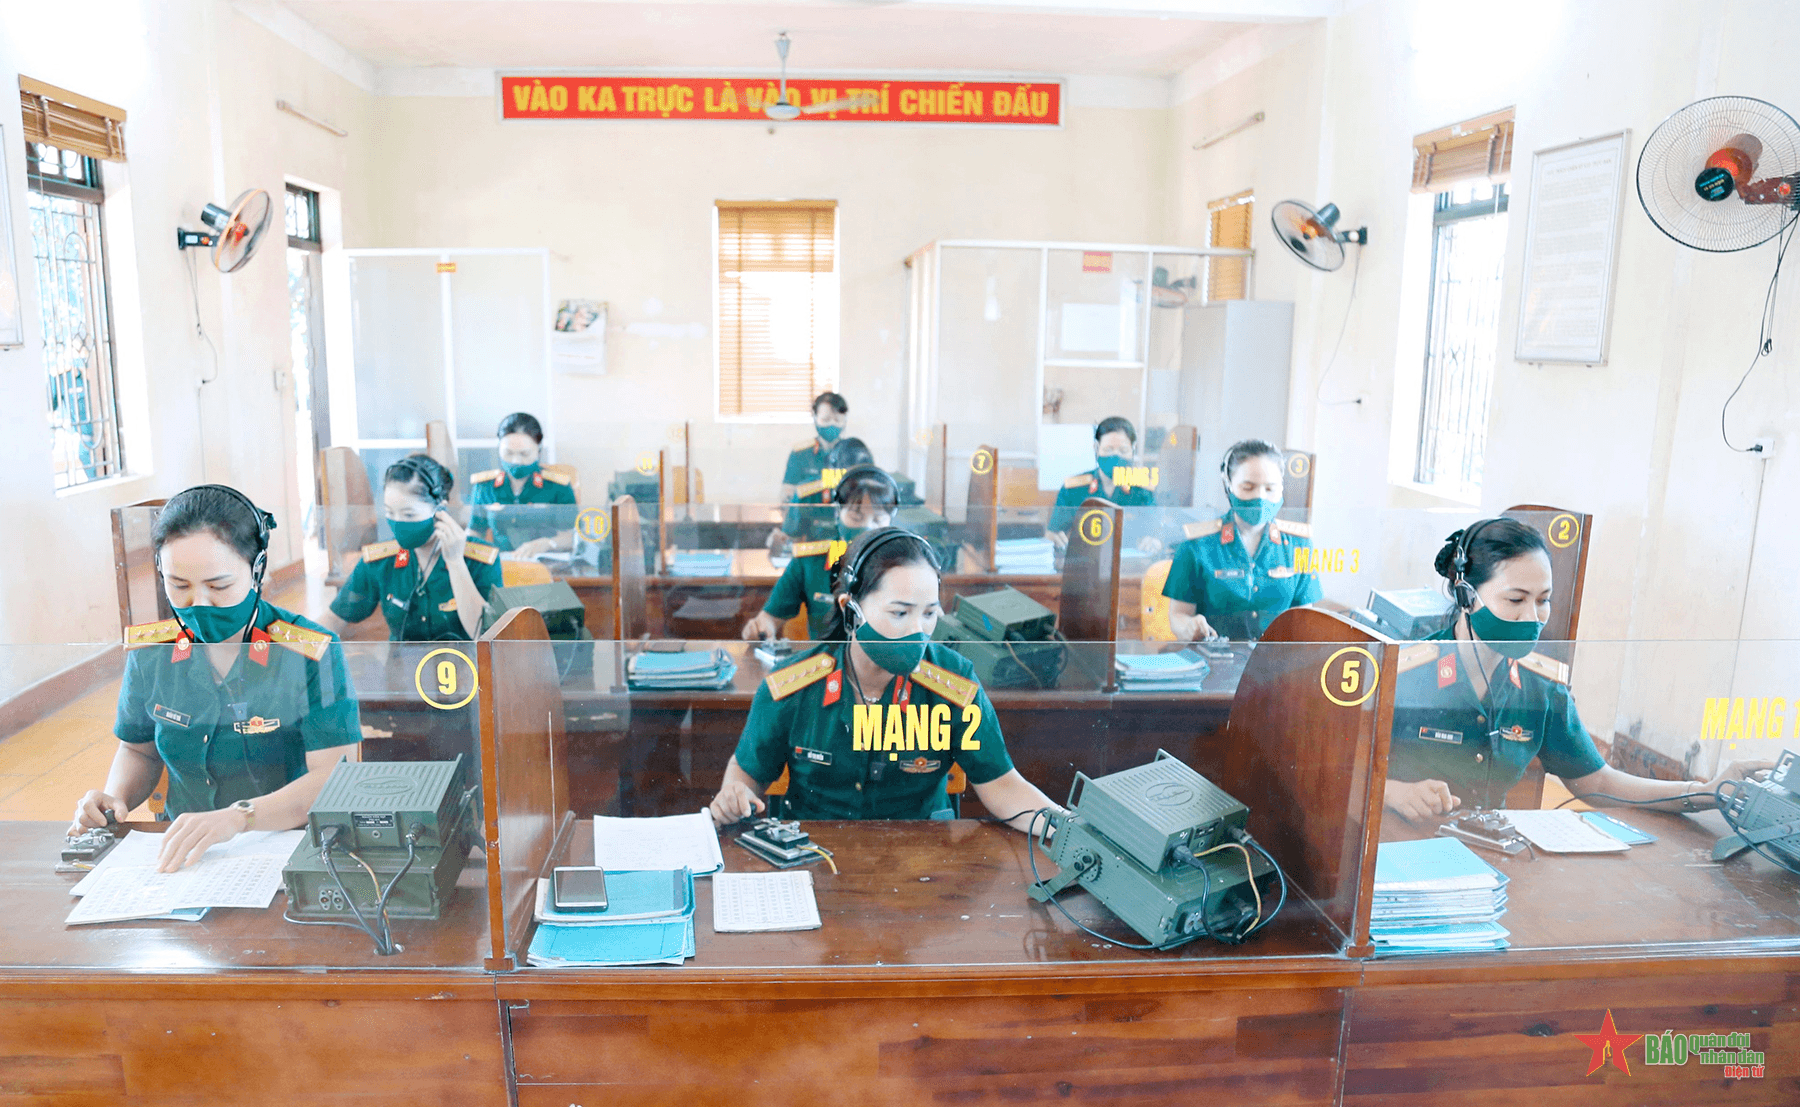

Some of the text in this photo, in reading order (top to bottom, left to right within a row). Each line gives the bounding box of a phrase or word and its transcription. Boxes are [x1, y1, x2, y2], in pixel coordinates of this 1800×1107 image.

[512, 79, 568, 112] VÀO
[578, 86, 617, 112] KA
[622, 84, 694, 118] TRỰC
[704, 80, 738, 113] LÀ
[900, 82, 983, 116] CHIẾN
[993, 83, 1049, 117] ĐẤU
[978, 455, 986, 469] 7
[1295, 459, 1303, 473] 3
[583, 515, 604, 535] 10
[1091, 517, 1102, 538] 6
[1558, 520, 1571, 540] 2
[1294, 548, 1360, 579] MẠNG 3
[437, 660, 457, 695] 9
[1341, 660, 1361, 694] 5
[853, 704, 981, 761] MẠNG 2
[1700, 697, 1786, 750] MẠNG
